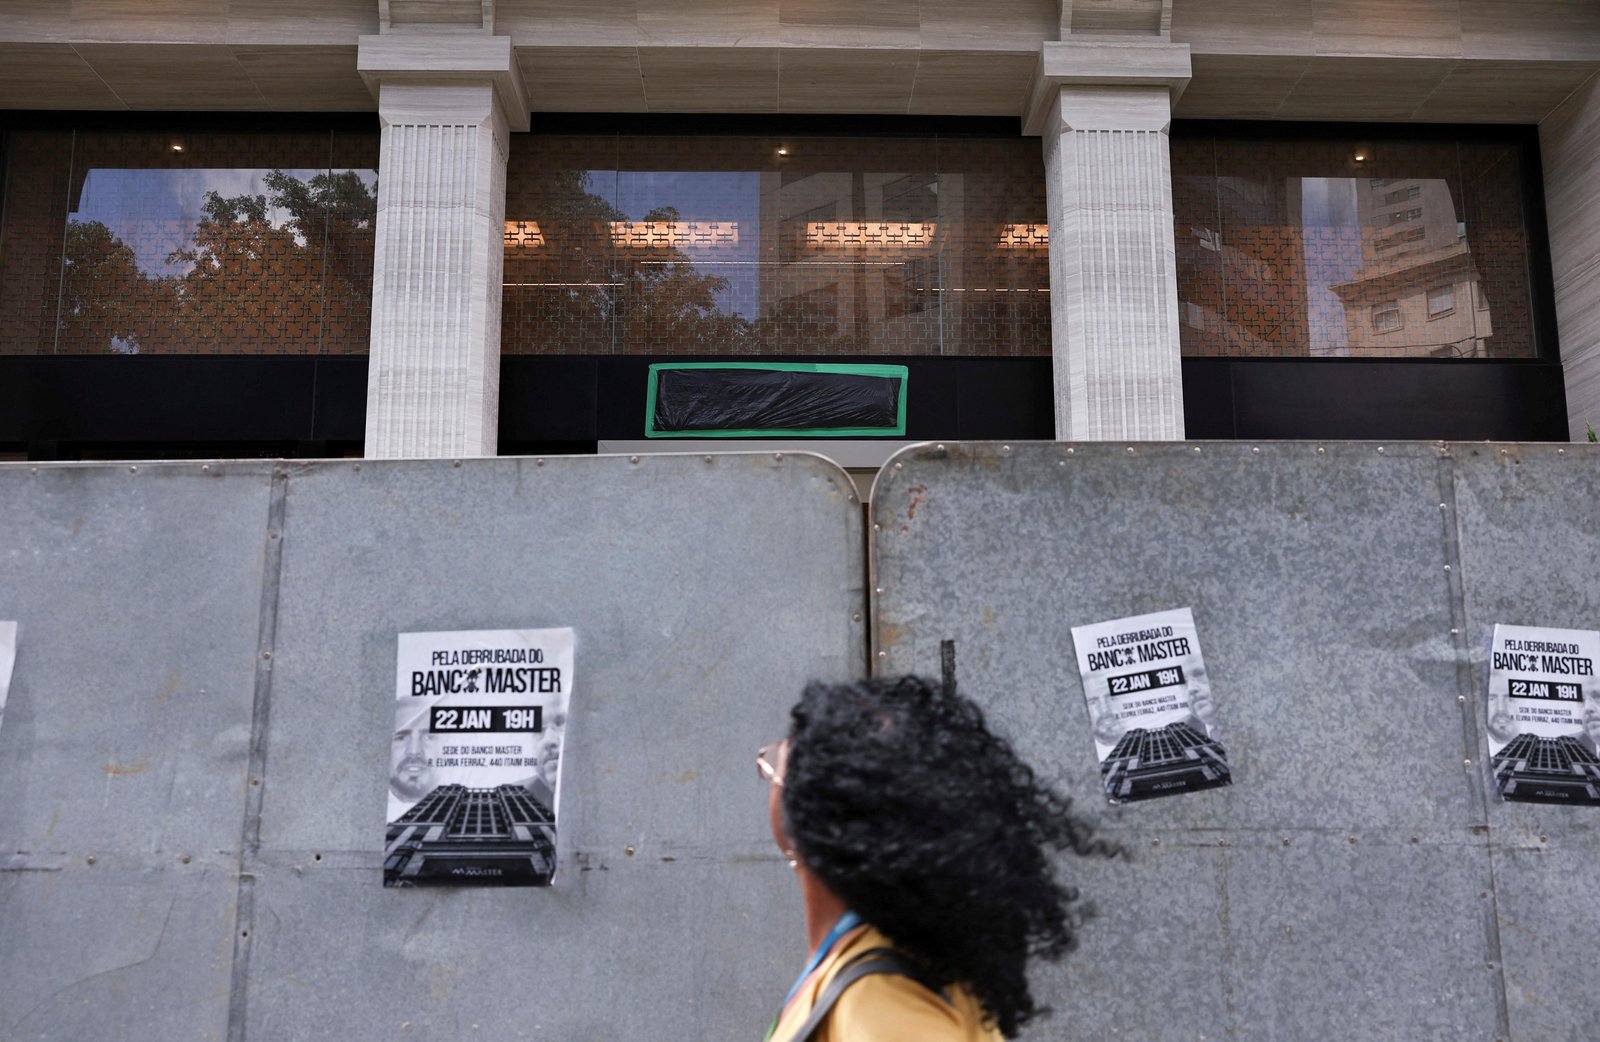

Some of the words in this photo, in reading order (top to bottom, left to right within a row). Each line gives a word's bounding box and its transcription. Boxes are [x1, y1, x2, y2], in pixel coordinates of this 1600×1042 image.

[1096, 635, 1117, 648] PELA
[1117, 628, 1162, 646] DERRUBADA
[1163, 626, 1174, 638] DO
[1504, 639, 1522, 651] PELA
[1523, 640, 1568, 654] DERRUBADA
[1568, 644, 1579, 655] DO
[432, 651, 460, 666] PELA
[461, 649, 527, 666] DERRUBADA
[528, 648, 544, 663] DO
[1136, 637, 1191, 663] MASTER
[1541, 655, 1593, 676] MASTER
[485, 667, 561, 693] MASTER
[1111, 678, 1128, 693] 22
[1129, 674, 1151, 690] JAN
[1156, 669, 1180, 686] 19H
[1511, 682, 1527, 696] 22
[1528, 683, 1550, 698] JAN
[1555, 685, 1578, 699] 19H
[434, 710, 458, 730] 22
[459, 709, 492, 730] JAN
[502, 709, 535, 729] 19H
[442, 746, 459, 755] SEDE
[460, 746, 470, 755] DO
[471, 746, 493, 754] BANCO
[495, 745, 522, 754] MASTER
[489, 758, 503, 767] 440
